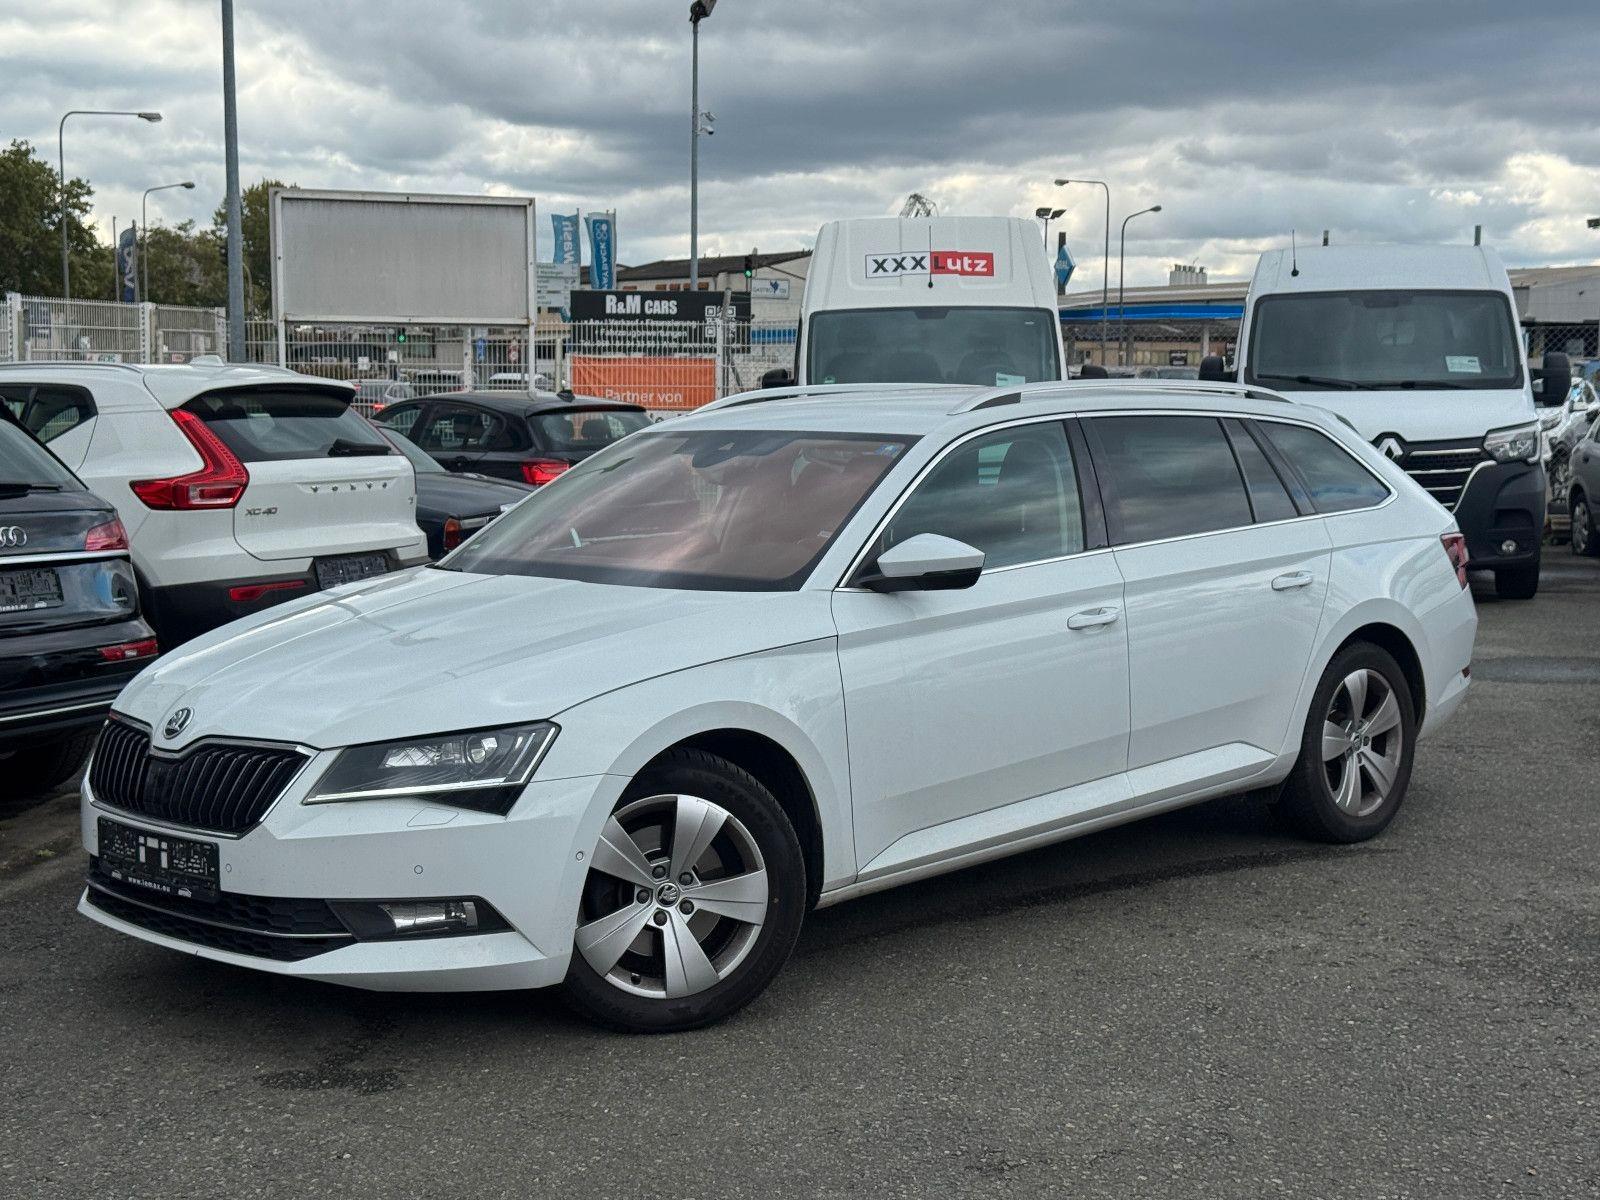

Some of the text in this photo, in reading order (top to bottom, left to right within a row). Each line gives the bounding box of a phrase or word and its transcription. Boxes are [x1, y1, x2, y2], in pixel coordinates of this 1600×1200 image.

[605, 295, 678, 315] R&M CARS
[605, 388, 682, 403] Partner von
